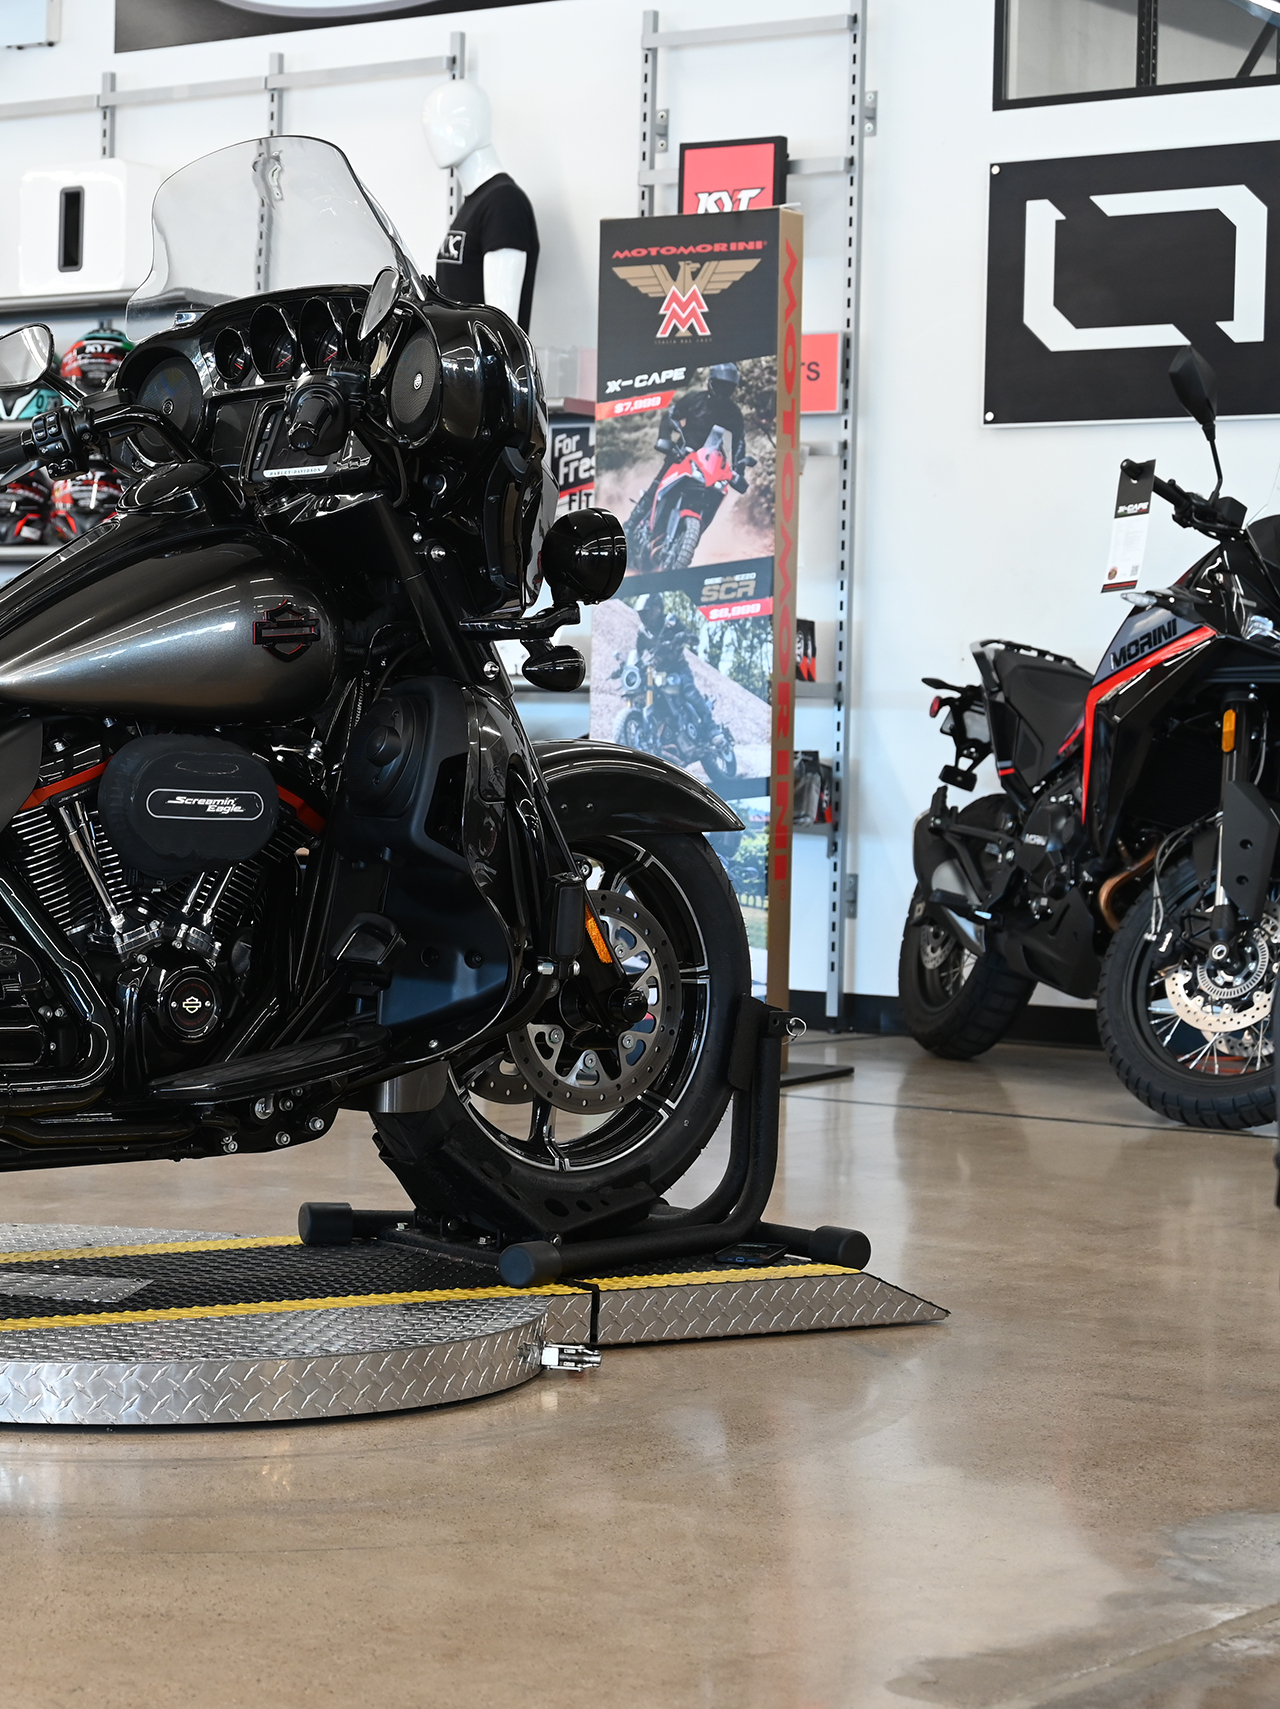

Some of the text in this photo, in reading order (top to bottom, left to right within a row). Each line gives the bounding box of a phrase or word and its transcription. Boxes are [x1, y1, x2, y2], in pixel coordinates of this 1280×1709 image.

[605, 367, 686, 394] X-CAPE
[554, 433, 580, 458] For
[700, 580, 756, 602] SCR
[1110, 618, 1177, 671] MORINI
[205, 804, 246, 815] Eagle
